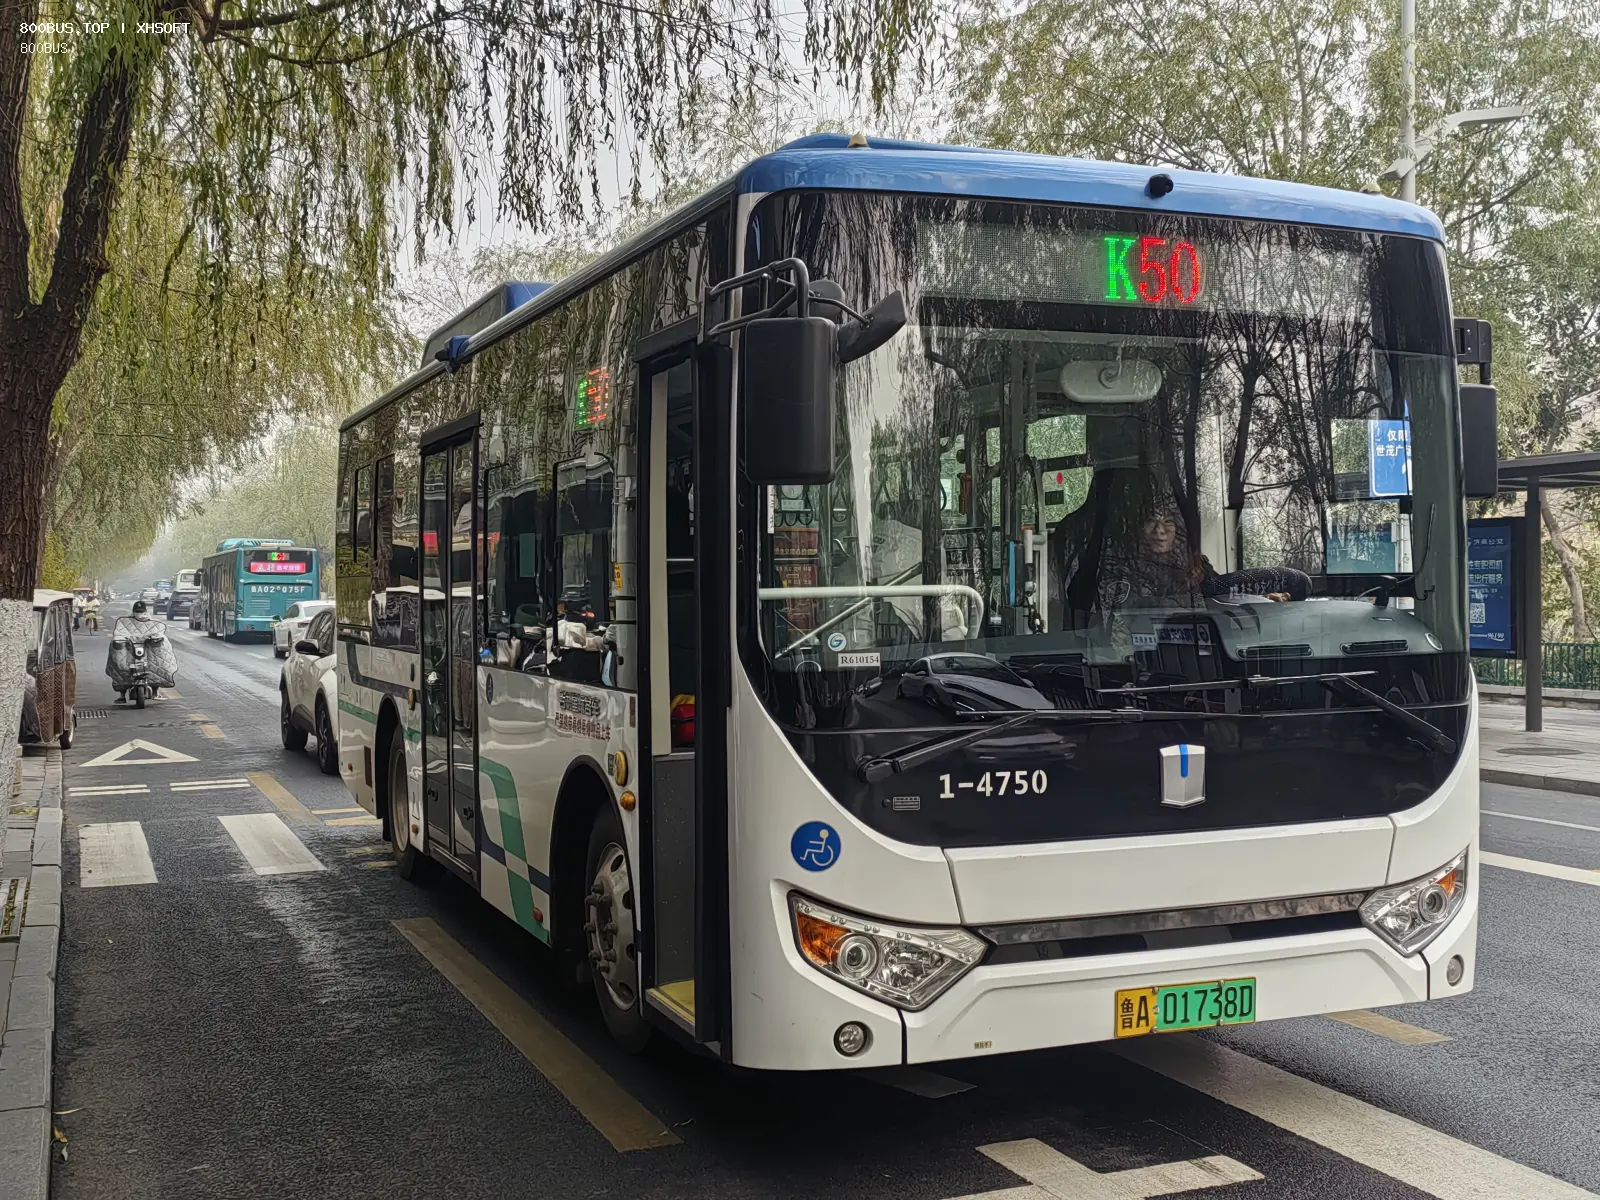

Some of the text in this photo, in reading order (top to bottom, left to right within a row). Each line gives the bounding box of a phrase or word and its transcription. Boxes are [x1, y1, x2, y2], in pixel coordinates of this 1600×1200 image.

[1104, 236, 1200, 304] K50
[840, 655, 880, 665] R610154
[939, 769, 1048, 799] 1-4750
[1120, 985, 1253, 1030] 鲁A01738D
